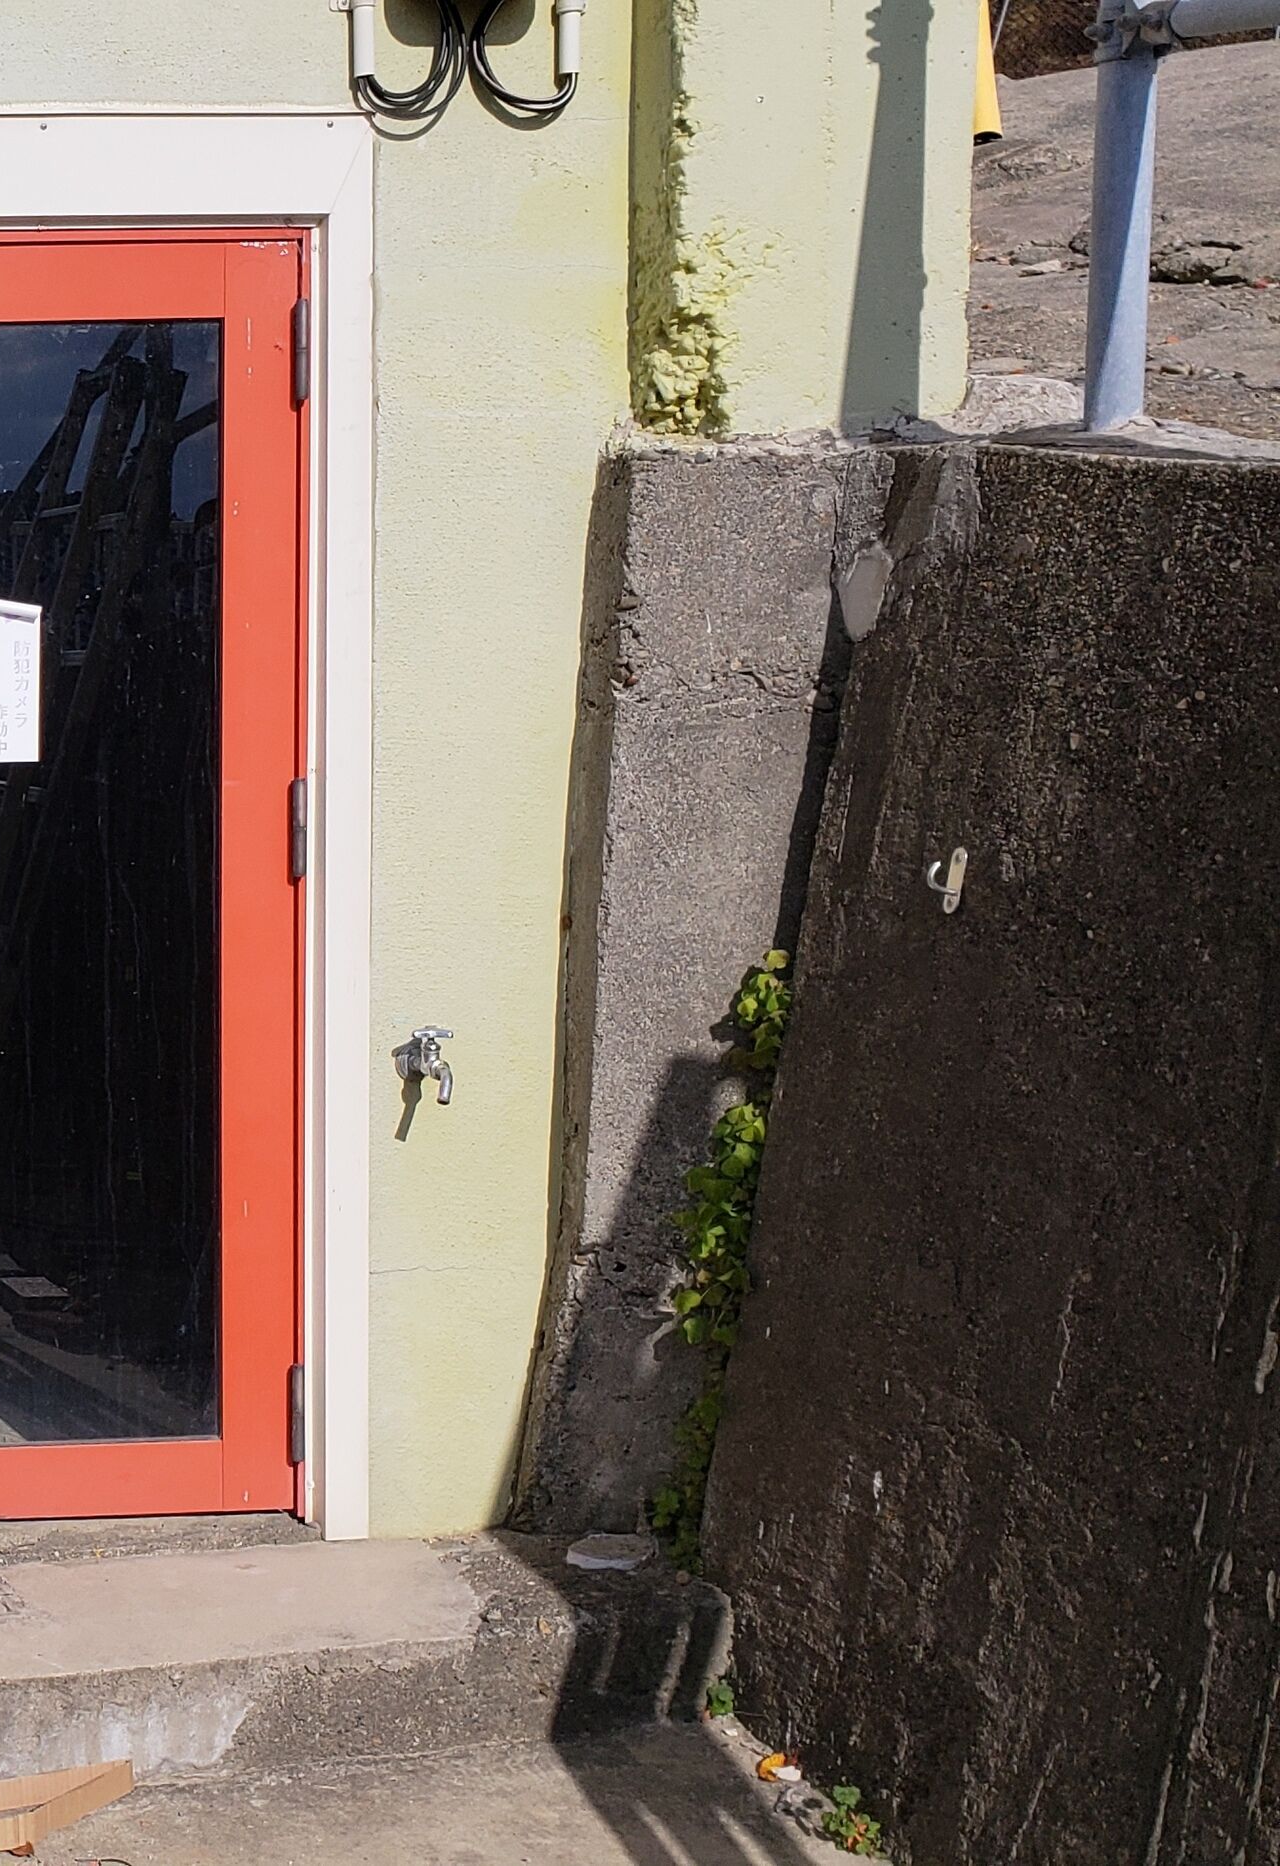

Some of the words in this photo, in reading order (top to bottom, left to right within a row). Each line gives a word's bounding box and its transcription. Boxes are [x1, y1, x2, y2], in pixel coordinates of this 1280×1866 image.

[13, 640, 31, 728] 防犯カメラ
